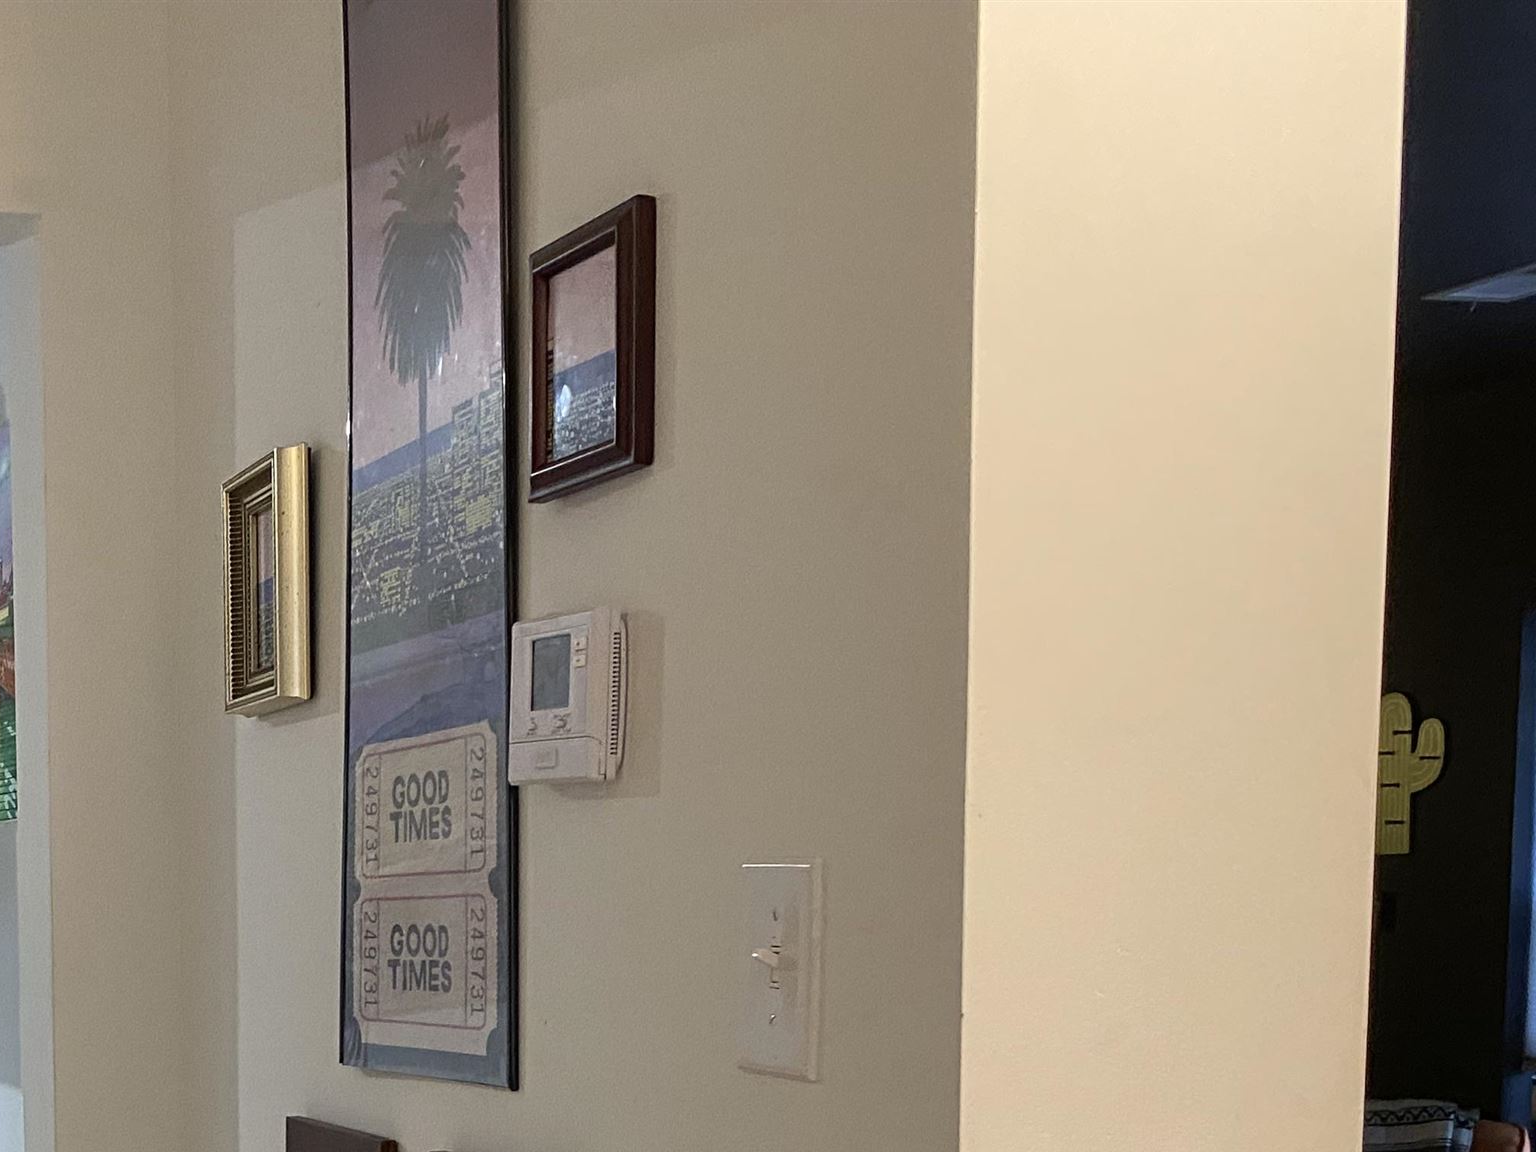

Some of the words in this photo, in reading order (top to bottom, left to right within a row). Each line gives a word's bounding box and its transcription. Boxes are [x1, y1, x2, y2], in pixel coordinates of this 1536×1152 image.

[392, 770, 449, 810] GOOD
[389, 805, 453, 843] TIMES
[390, 923, 449, 958] GOOD
[387, 959, 452, 993] TIMES
